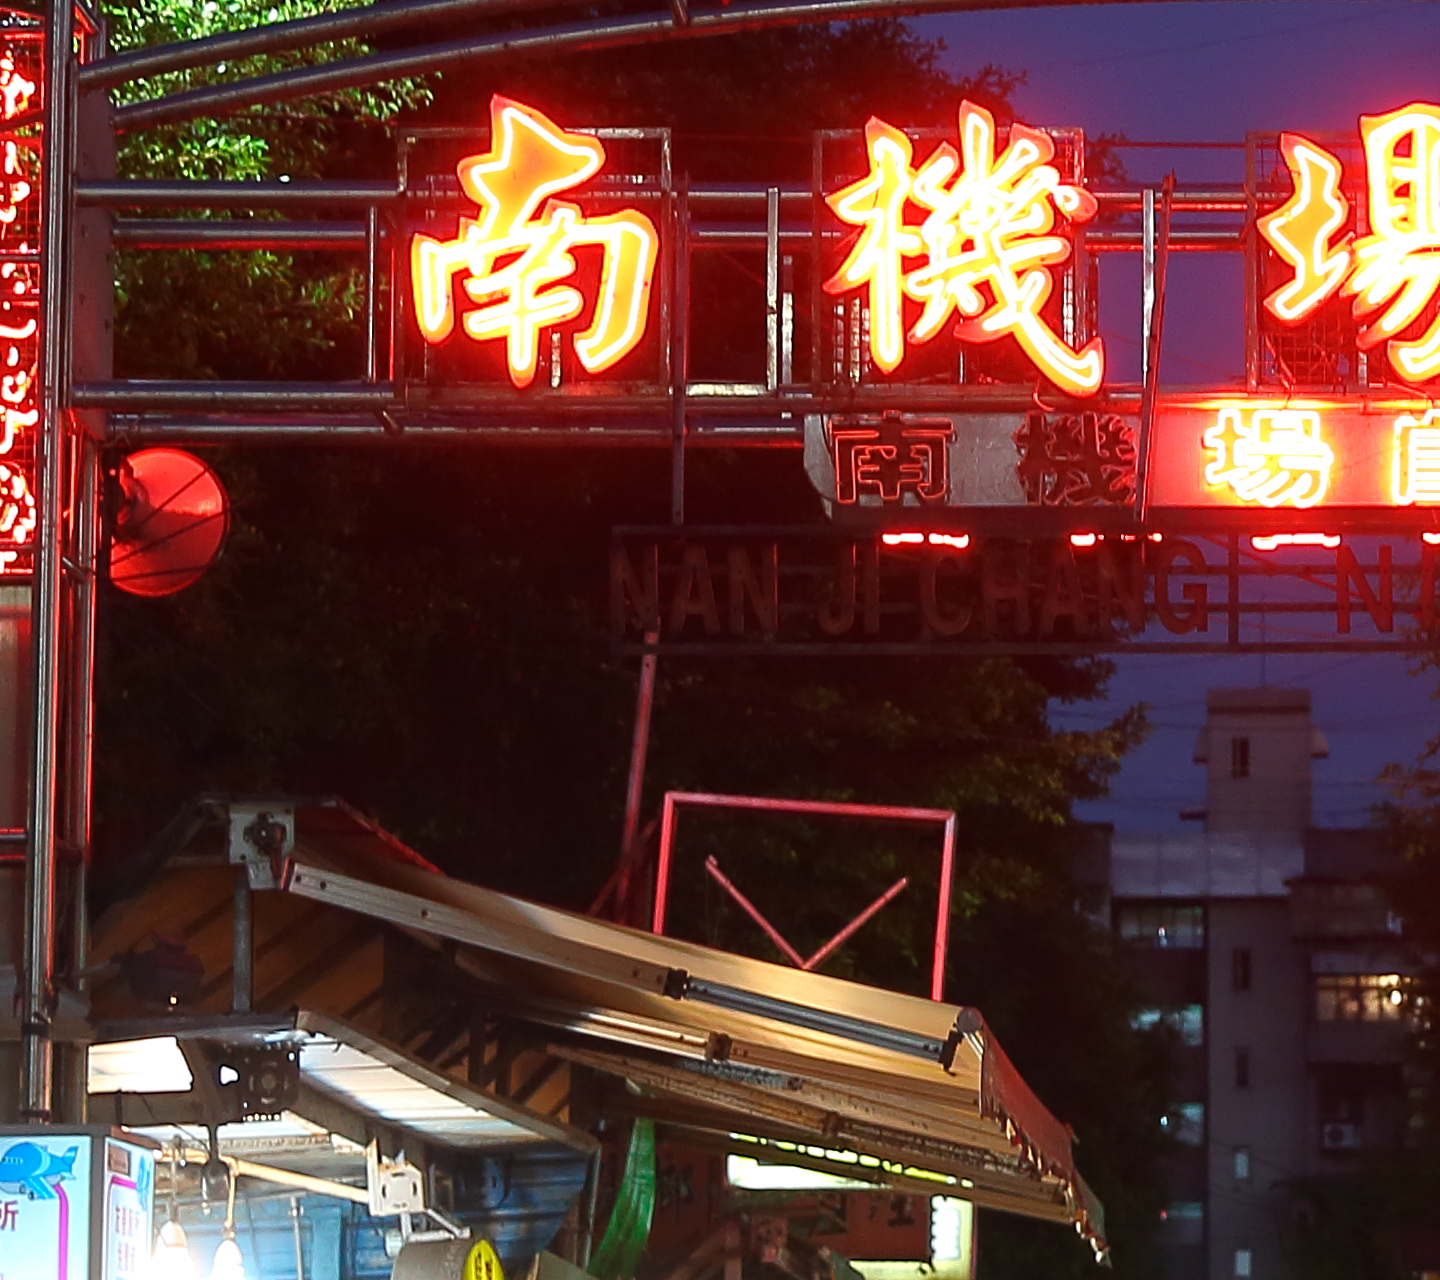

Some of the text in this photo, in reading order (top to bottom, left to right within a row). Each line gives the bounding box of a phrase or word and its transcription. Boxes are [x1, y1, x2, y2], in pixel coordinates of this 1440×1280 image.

[613, 542, 778, 635] NAN
[818, 542, 882, 635] JI
[919, 540, 1208, 635] CHANG
